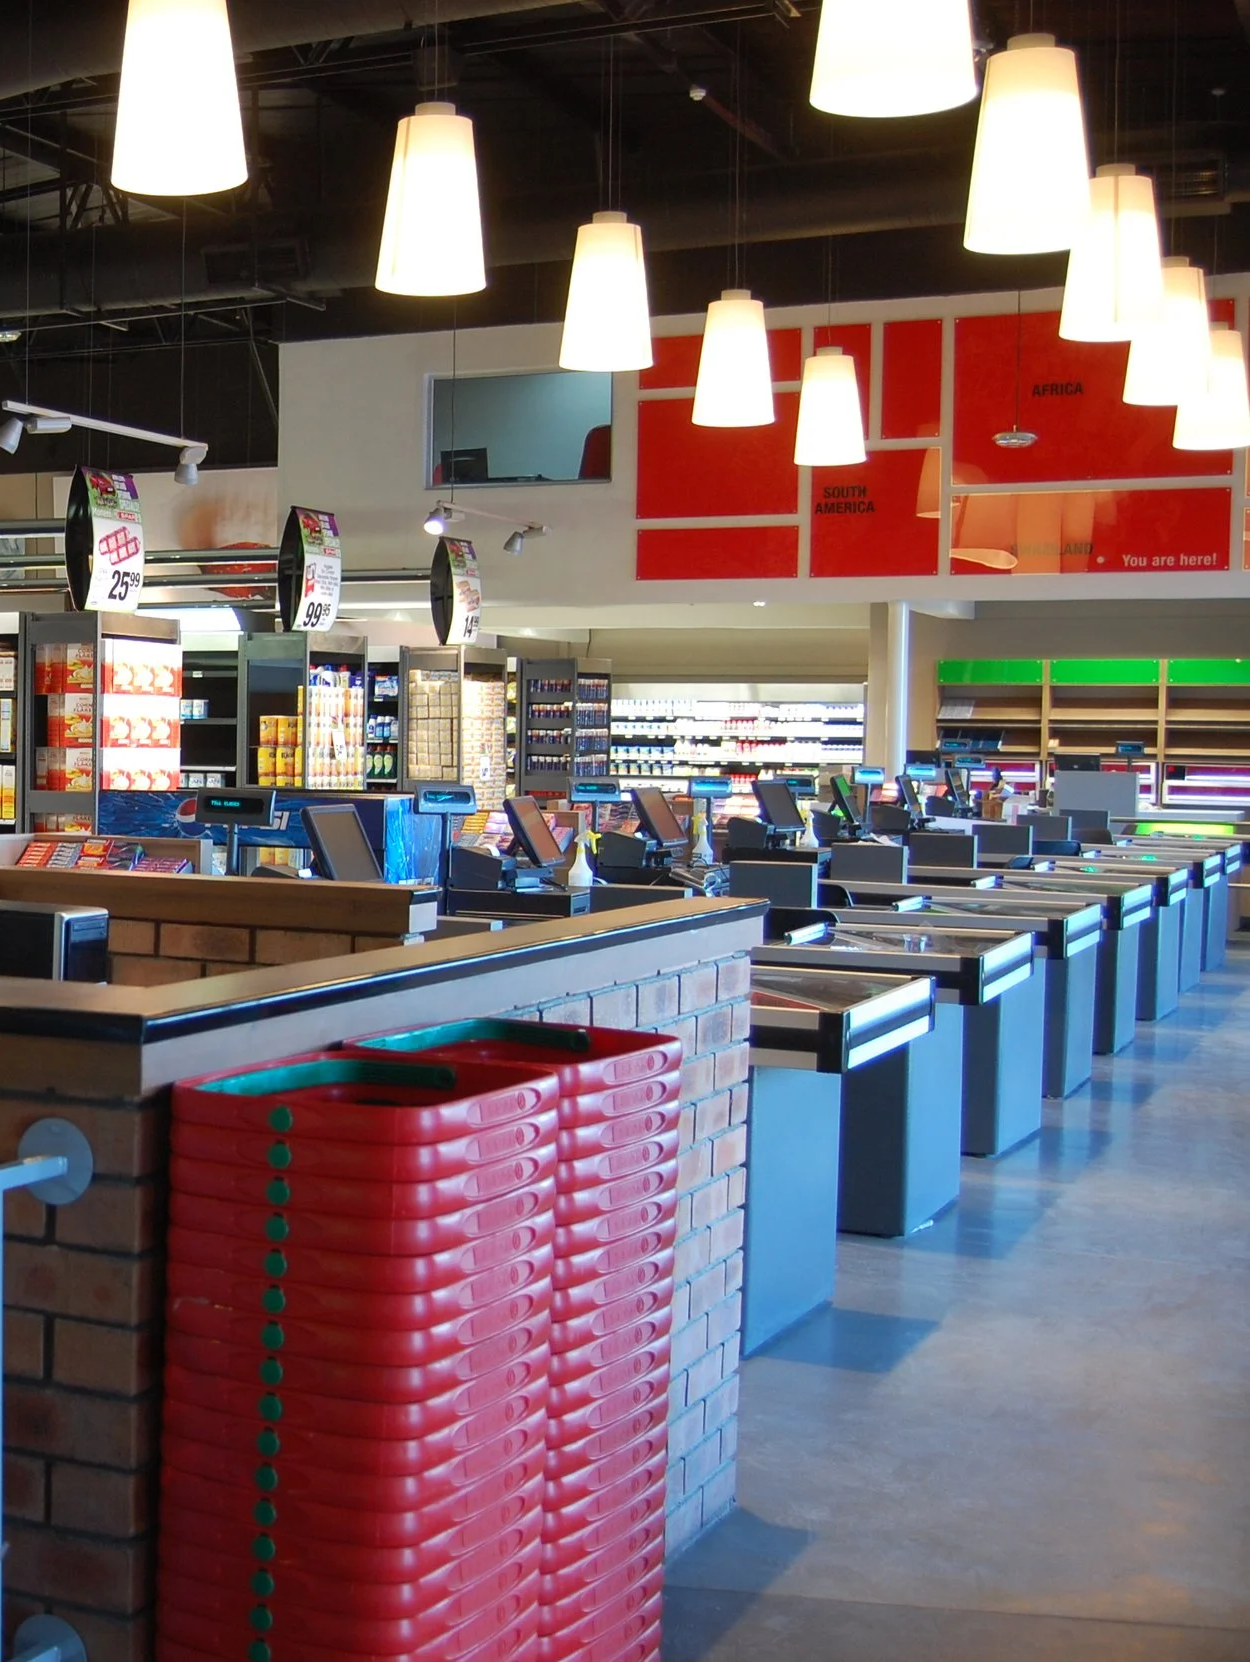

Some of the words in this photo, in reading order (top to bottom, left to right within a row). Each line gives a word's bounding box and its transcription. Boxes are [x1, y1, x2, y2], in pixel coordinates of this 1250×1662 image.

[1032, 382, 1084, 397] AFRICA
[823, 486, 868, 499] SOUTH
[815, 501, 876, 515] AMERICA
[1122, 554, 1147, 567] You
[1152, 556, 1175, 567] are
[1180, 553, 1218, 566] here!
